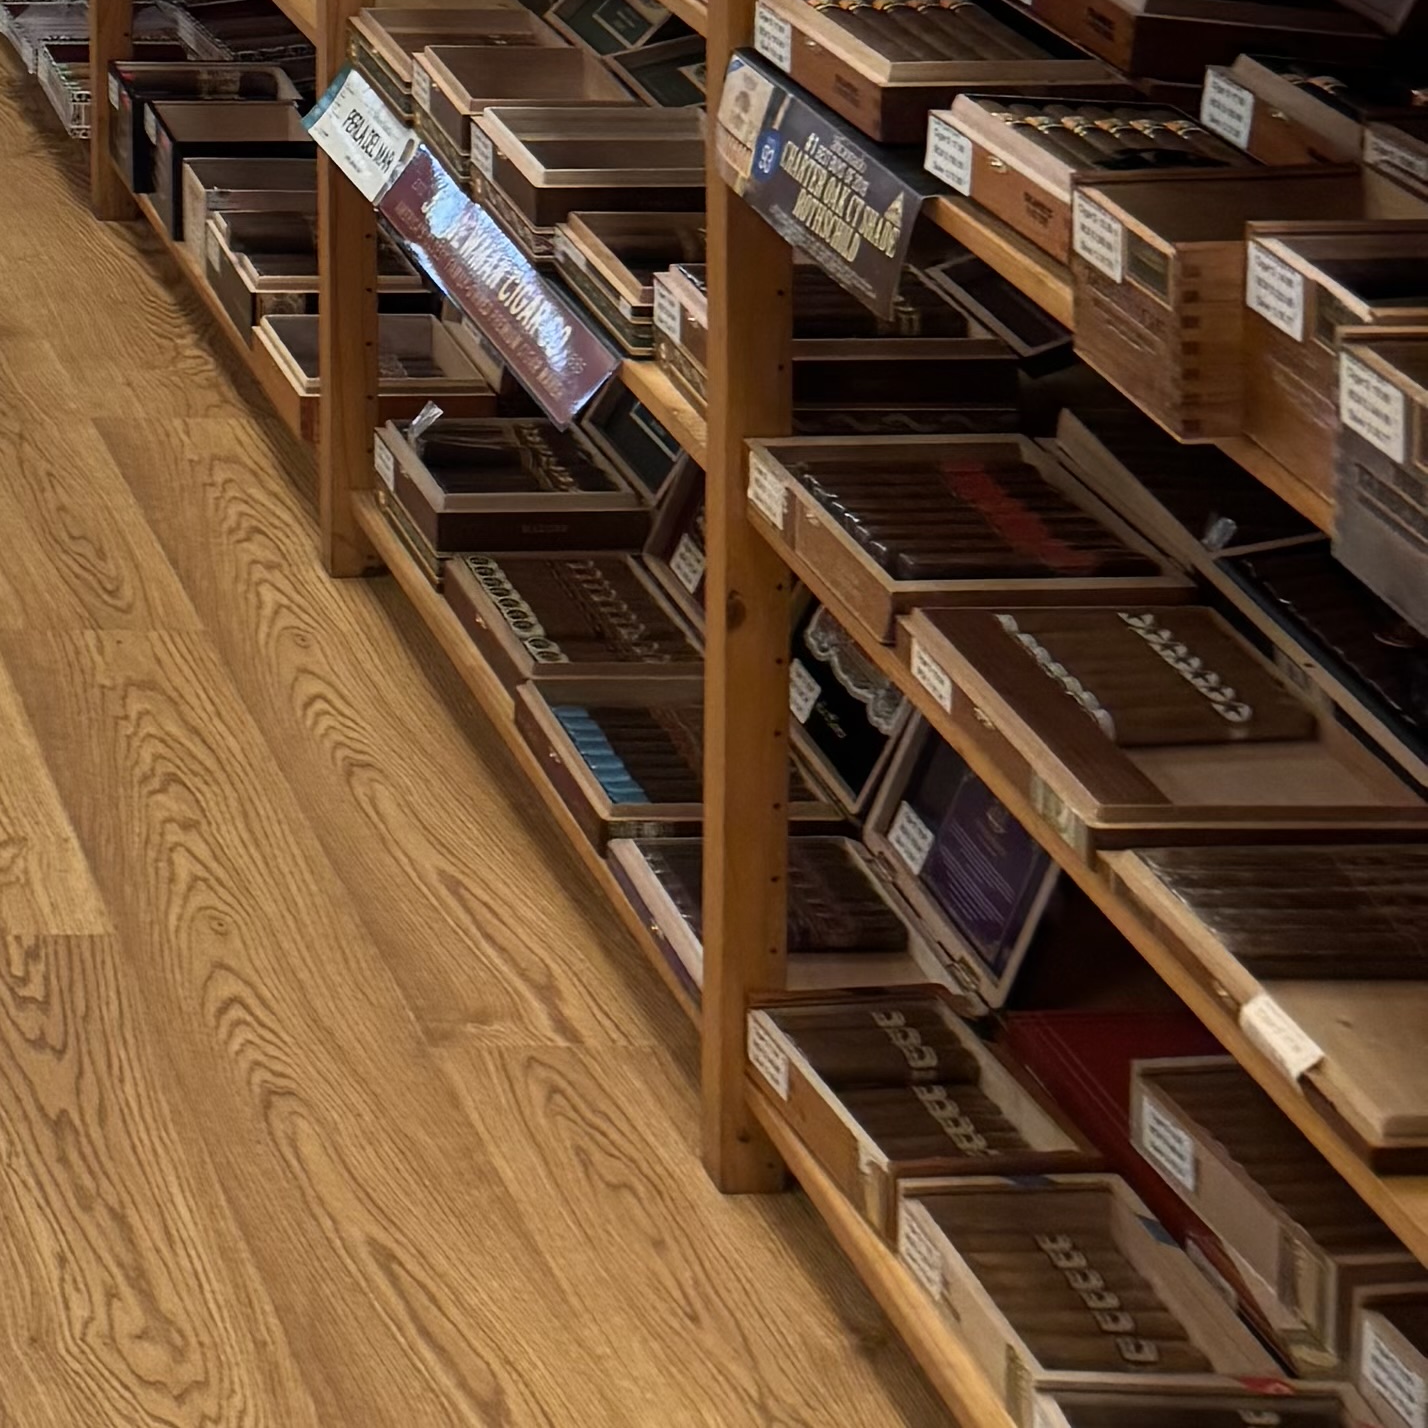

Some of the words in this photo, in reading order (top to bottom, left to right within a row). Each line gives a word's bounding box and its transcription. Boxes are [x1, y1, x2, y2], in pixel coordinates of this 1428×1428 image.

[780, 140, 828, 199] CHARTER
[824, 175, 850, 217] OAK
[859, 205, 901, 258] SHADE
[793, 189, 860, 262] ROTHSCHILD
